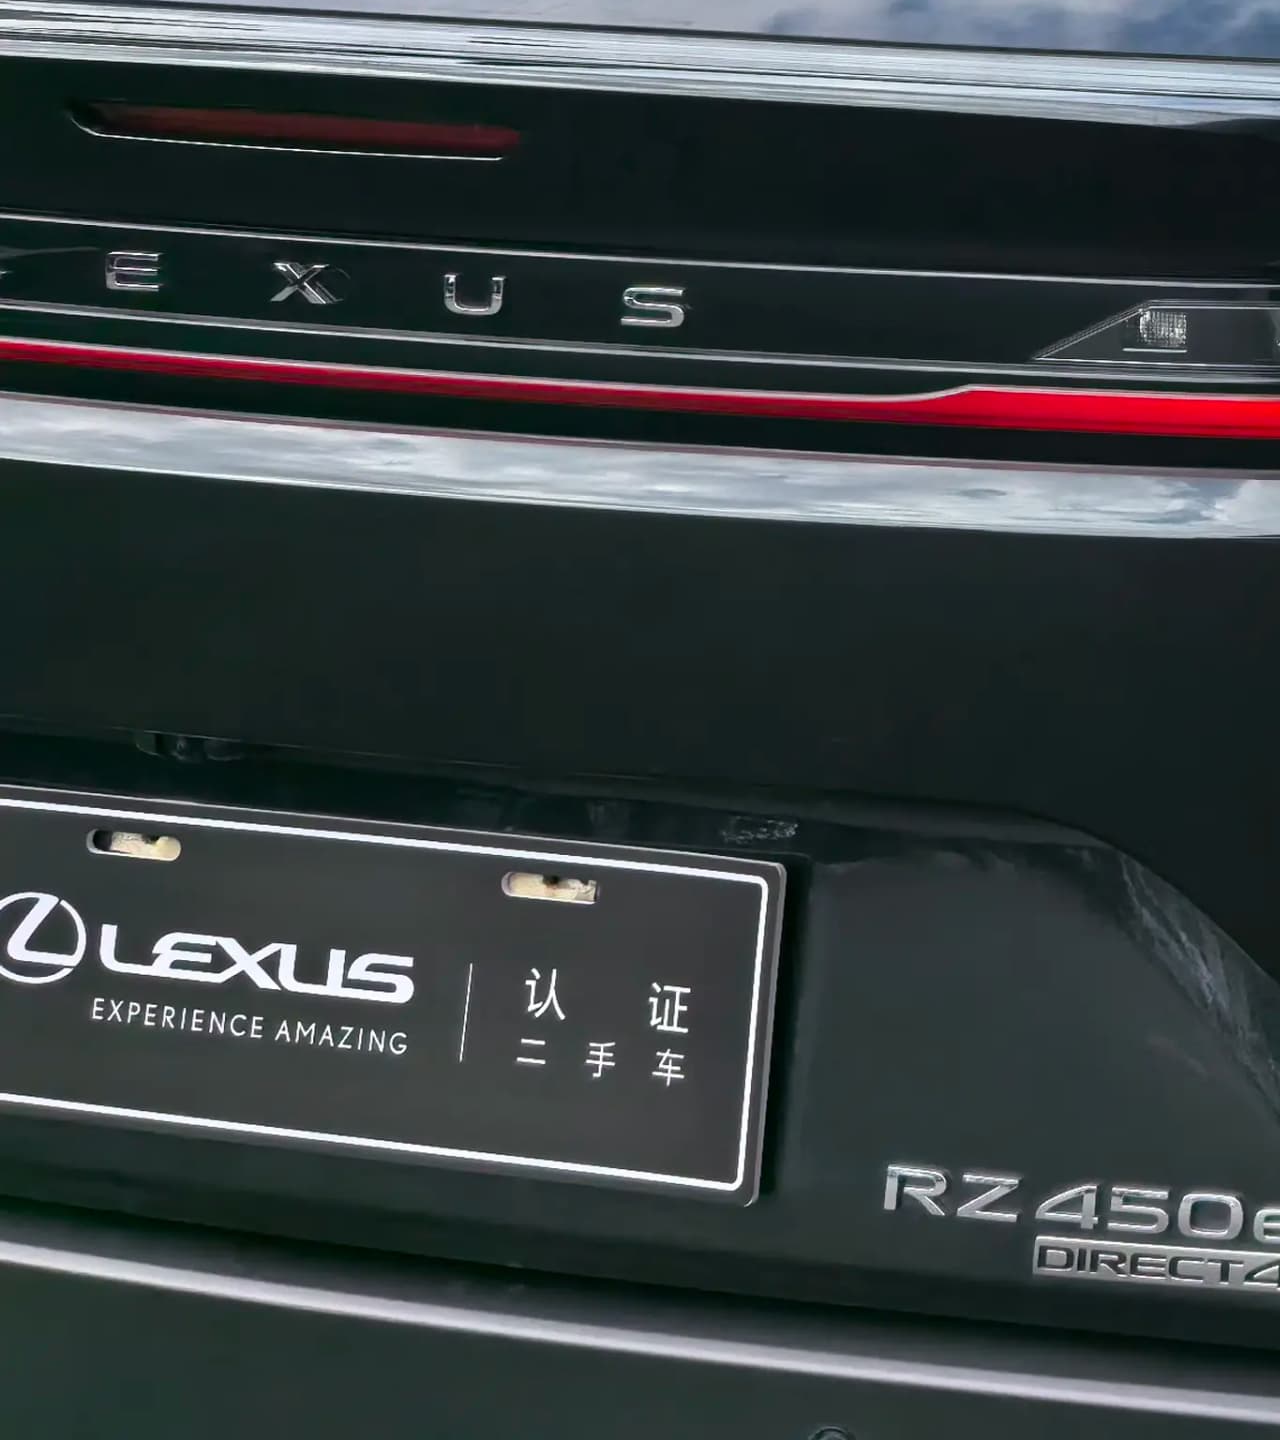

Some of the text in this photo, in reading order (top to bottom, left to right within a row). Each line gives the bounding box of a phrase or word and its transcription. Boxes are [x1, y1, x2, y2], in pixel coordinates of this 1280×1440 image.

[0, 249, 690, 330] EXUS
[99, 923, 415, 1004] LEXUS
[91, 997, 408, 1056] EXPERIENCE AMAZING
[524, 967, 692, 1035] 认证
[516, 1038, 686, 1087] 二手车
[883, 1164, 1021, 1222] RZ
